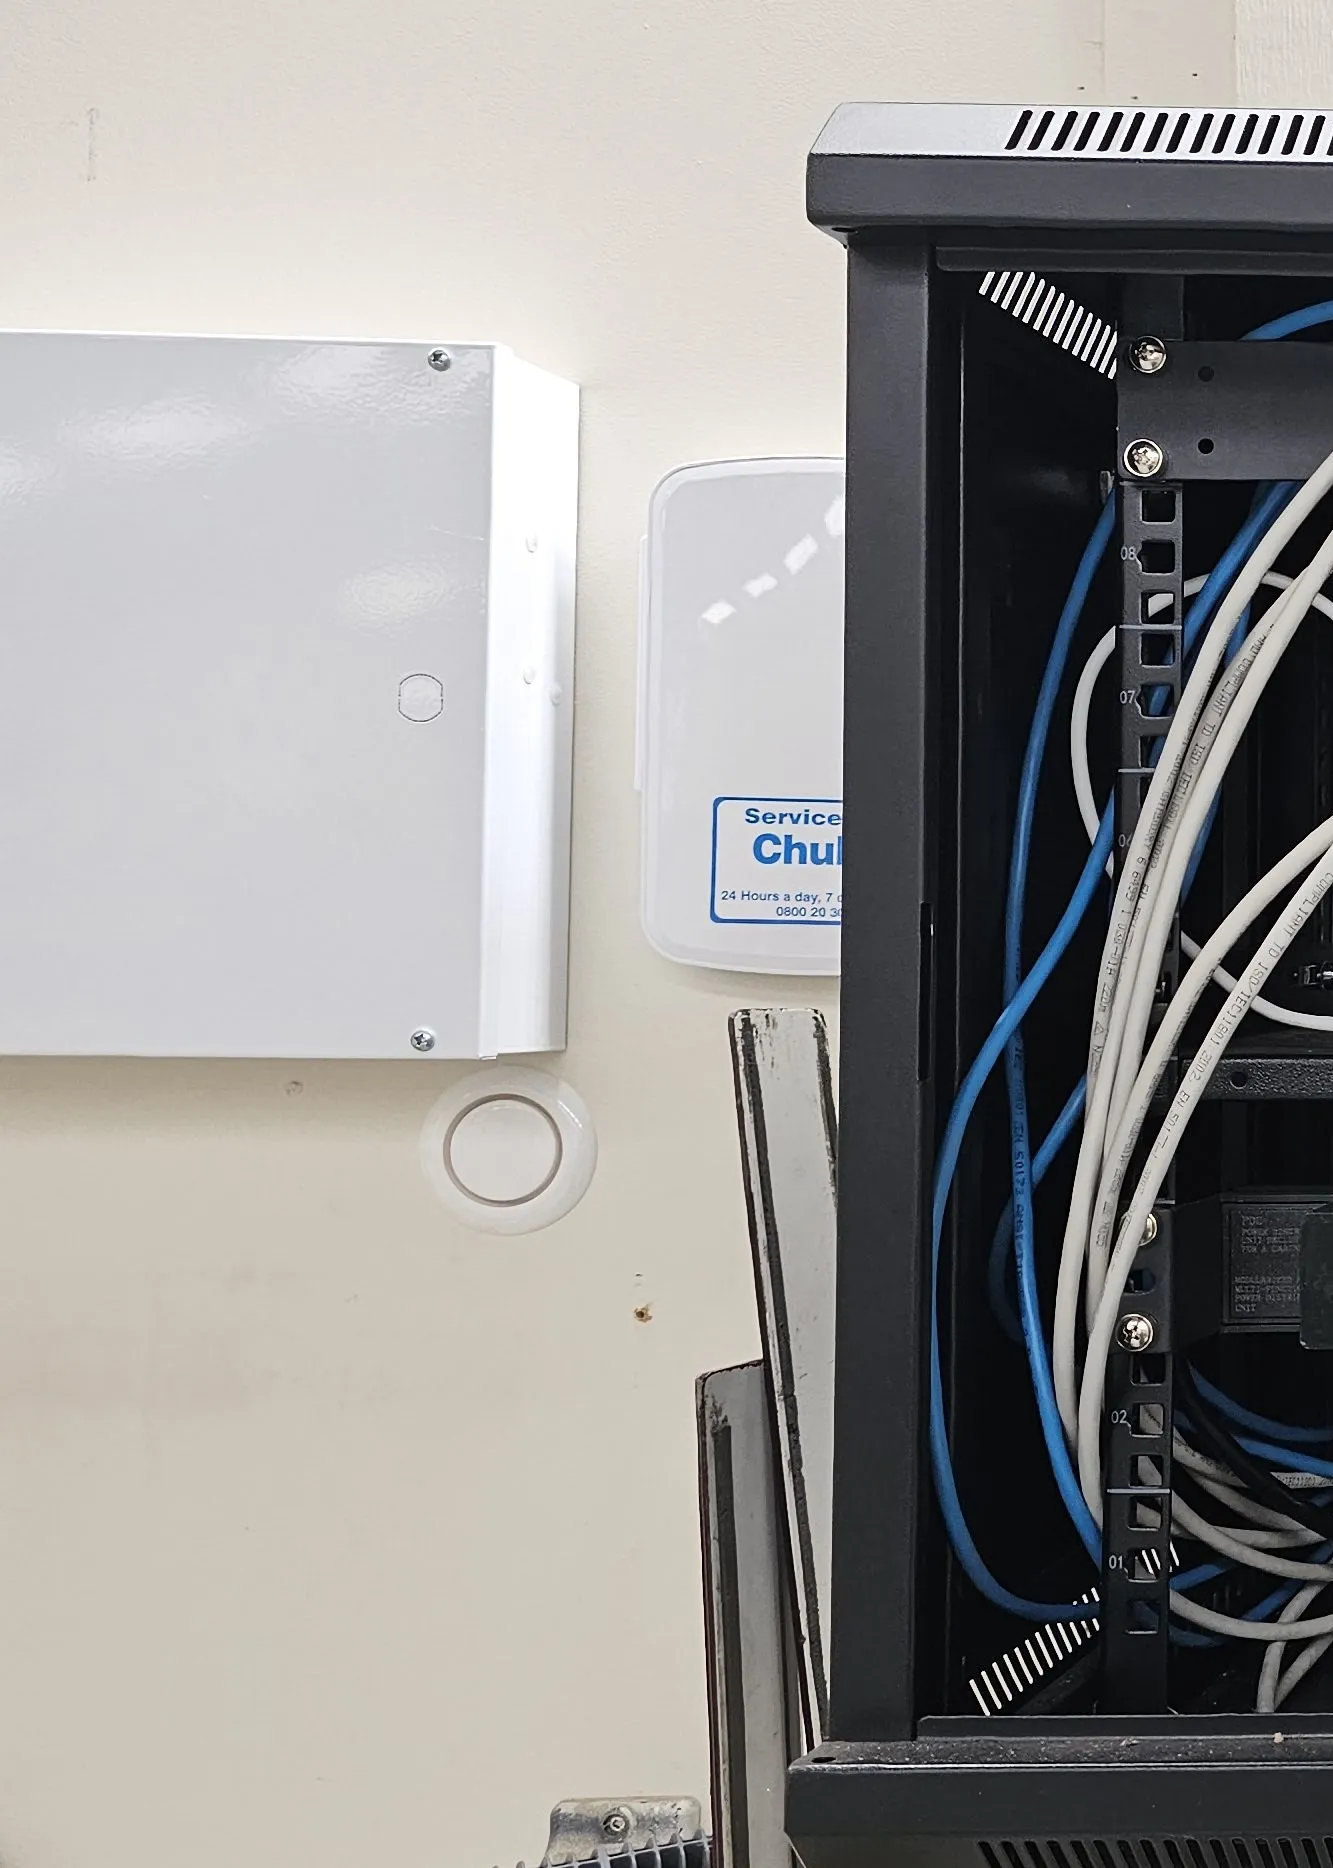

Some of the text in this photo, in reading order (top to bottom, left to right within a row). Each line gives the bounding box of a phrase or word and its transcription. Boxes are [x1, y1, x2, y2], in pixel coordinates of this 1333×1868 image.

[1120, 546, 1136, 561] 08
[1119, 690, 1136, 705] 07
[752, 832, 842, 866] Chu
[720, 890, 737, 901] 24
[741, 891, 780, 902] Hours
[783, 892, 791, 902] a
[794, 892, 822, 905] day,
[825, 892, 834, 903] 7
[775, 906, 808, 918] 0800
[810, 907, 827, 918] 20
[1110, 1409, 1128, 1425] 02
[1108, 1555, 1125, 1570] 01
